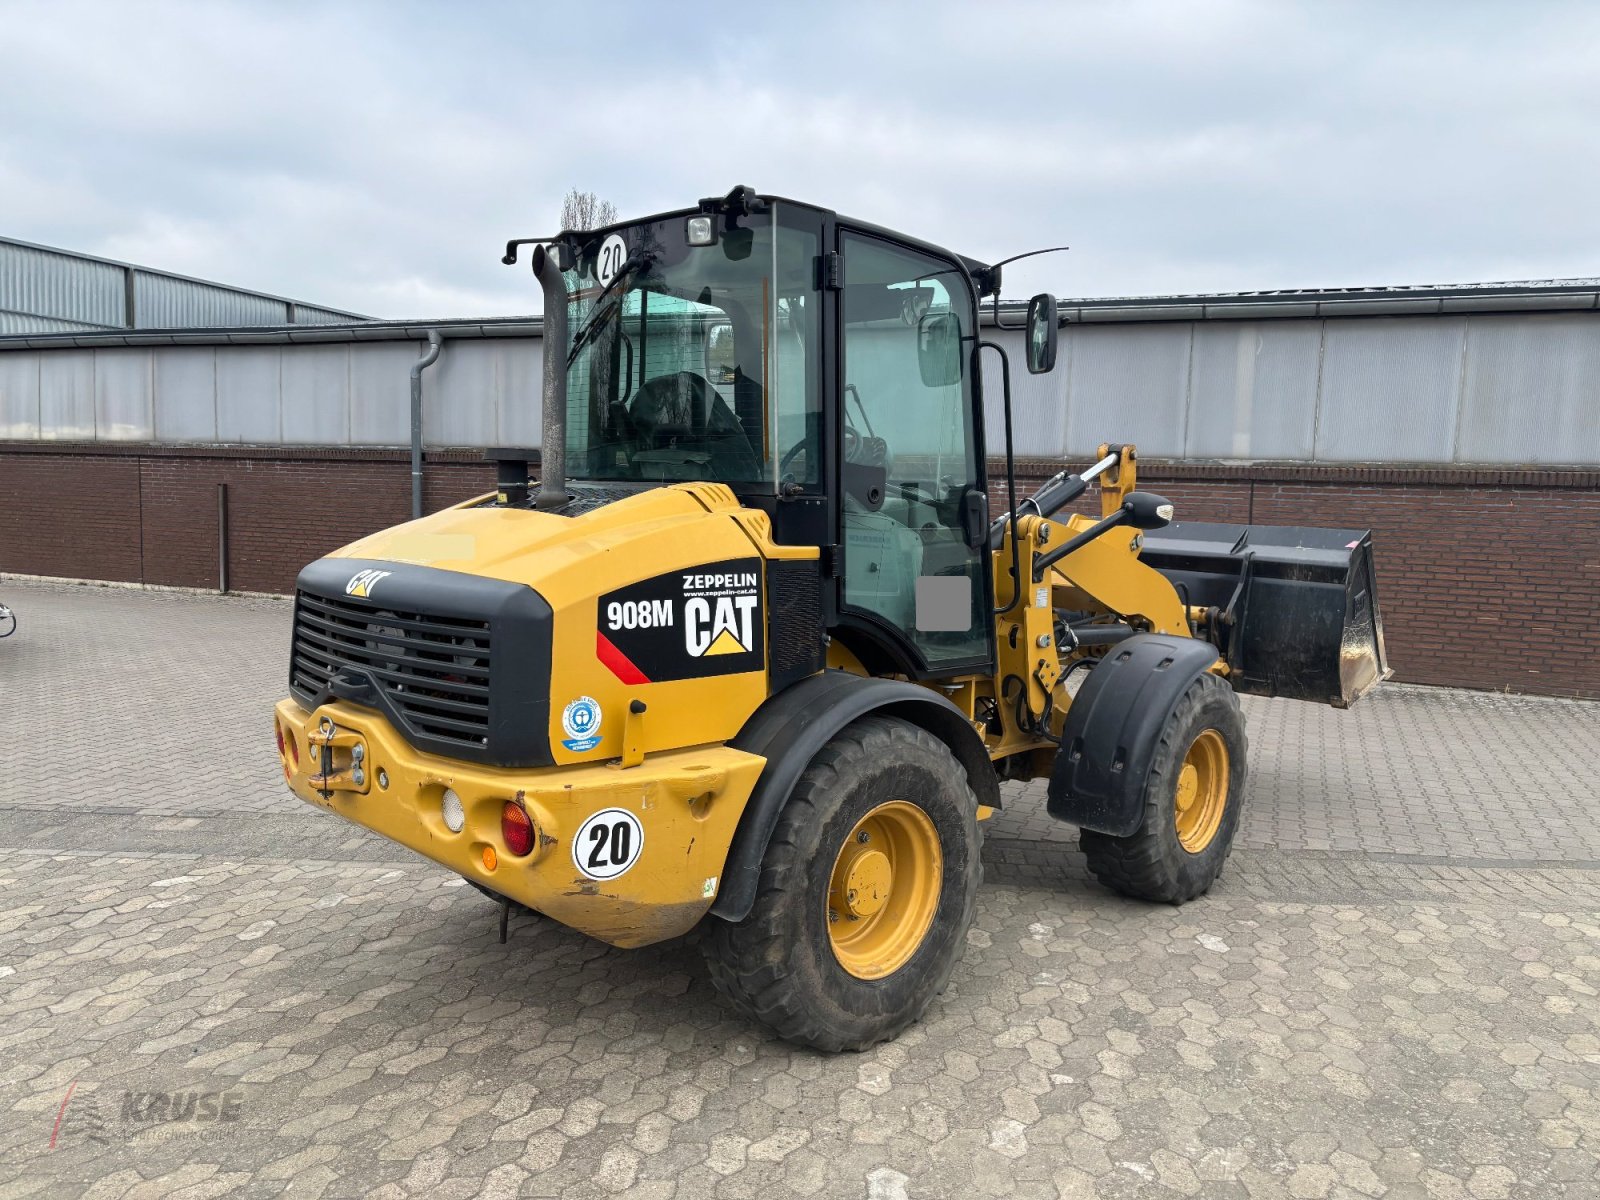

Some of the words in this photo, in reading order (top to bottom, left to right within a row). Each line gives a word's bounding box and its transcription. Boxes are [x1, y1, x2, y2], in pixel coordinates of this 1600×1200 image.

[602, 243, 621, 280] 20
[345, 569, 392, 598] CAT
[682, 573, 757, 589] ZEPPELIN
[683, 588, 758, 598] www.zeppelin-cat.de
[607, 599, 674, 631] 908M
[684, 595, 758, 657] CAT
[587, 821, 631, 869] 20
